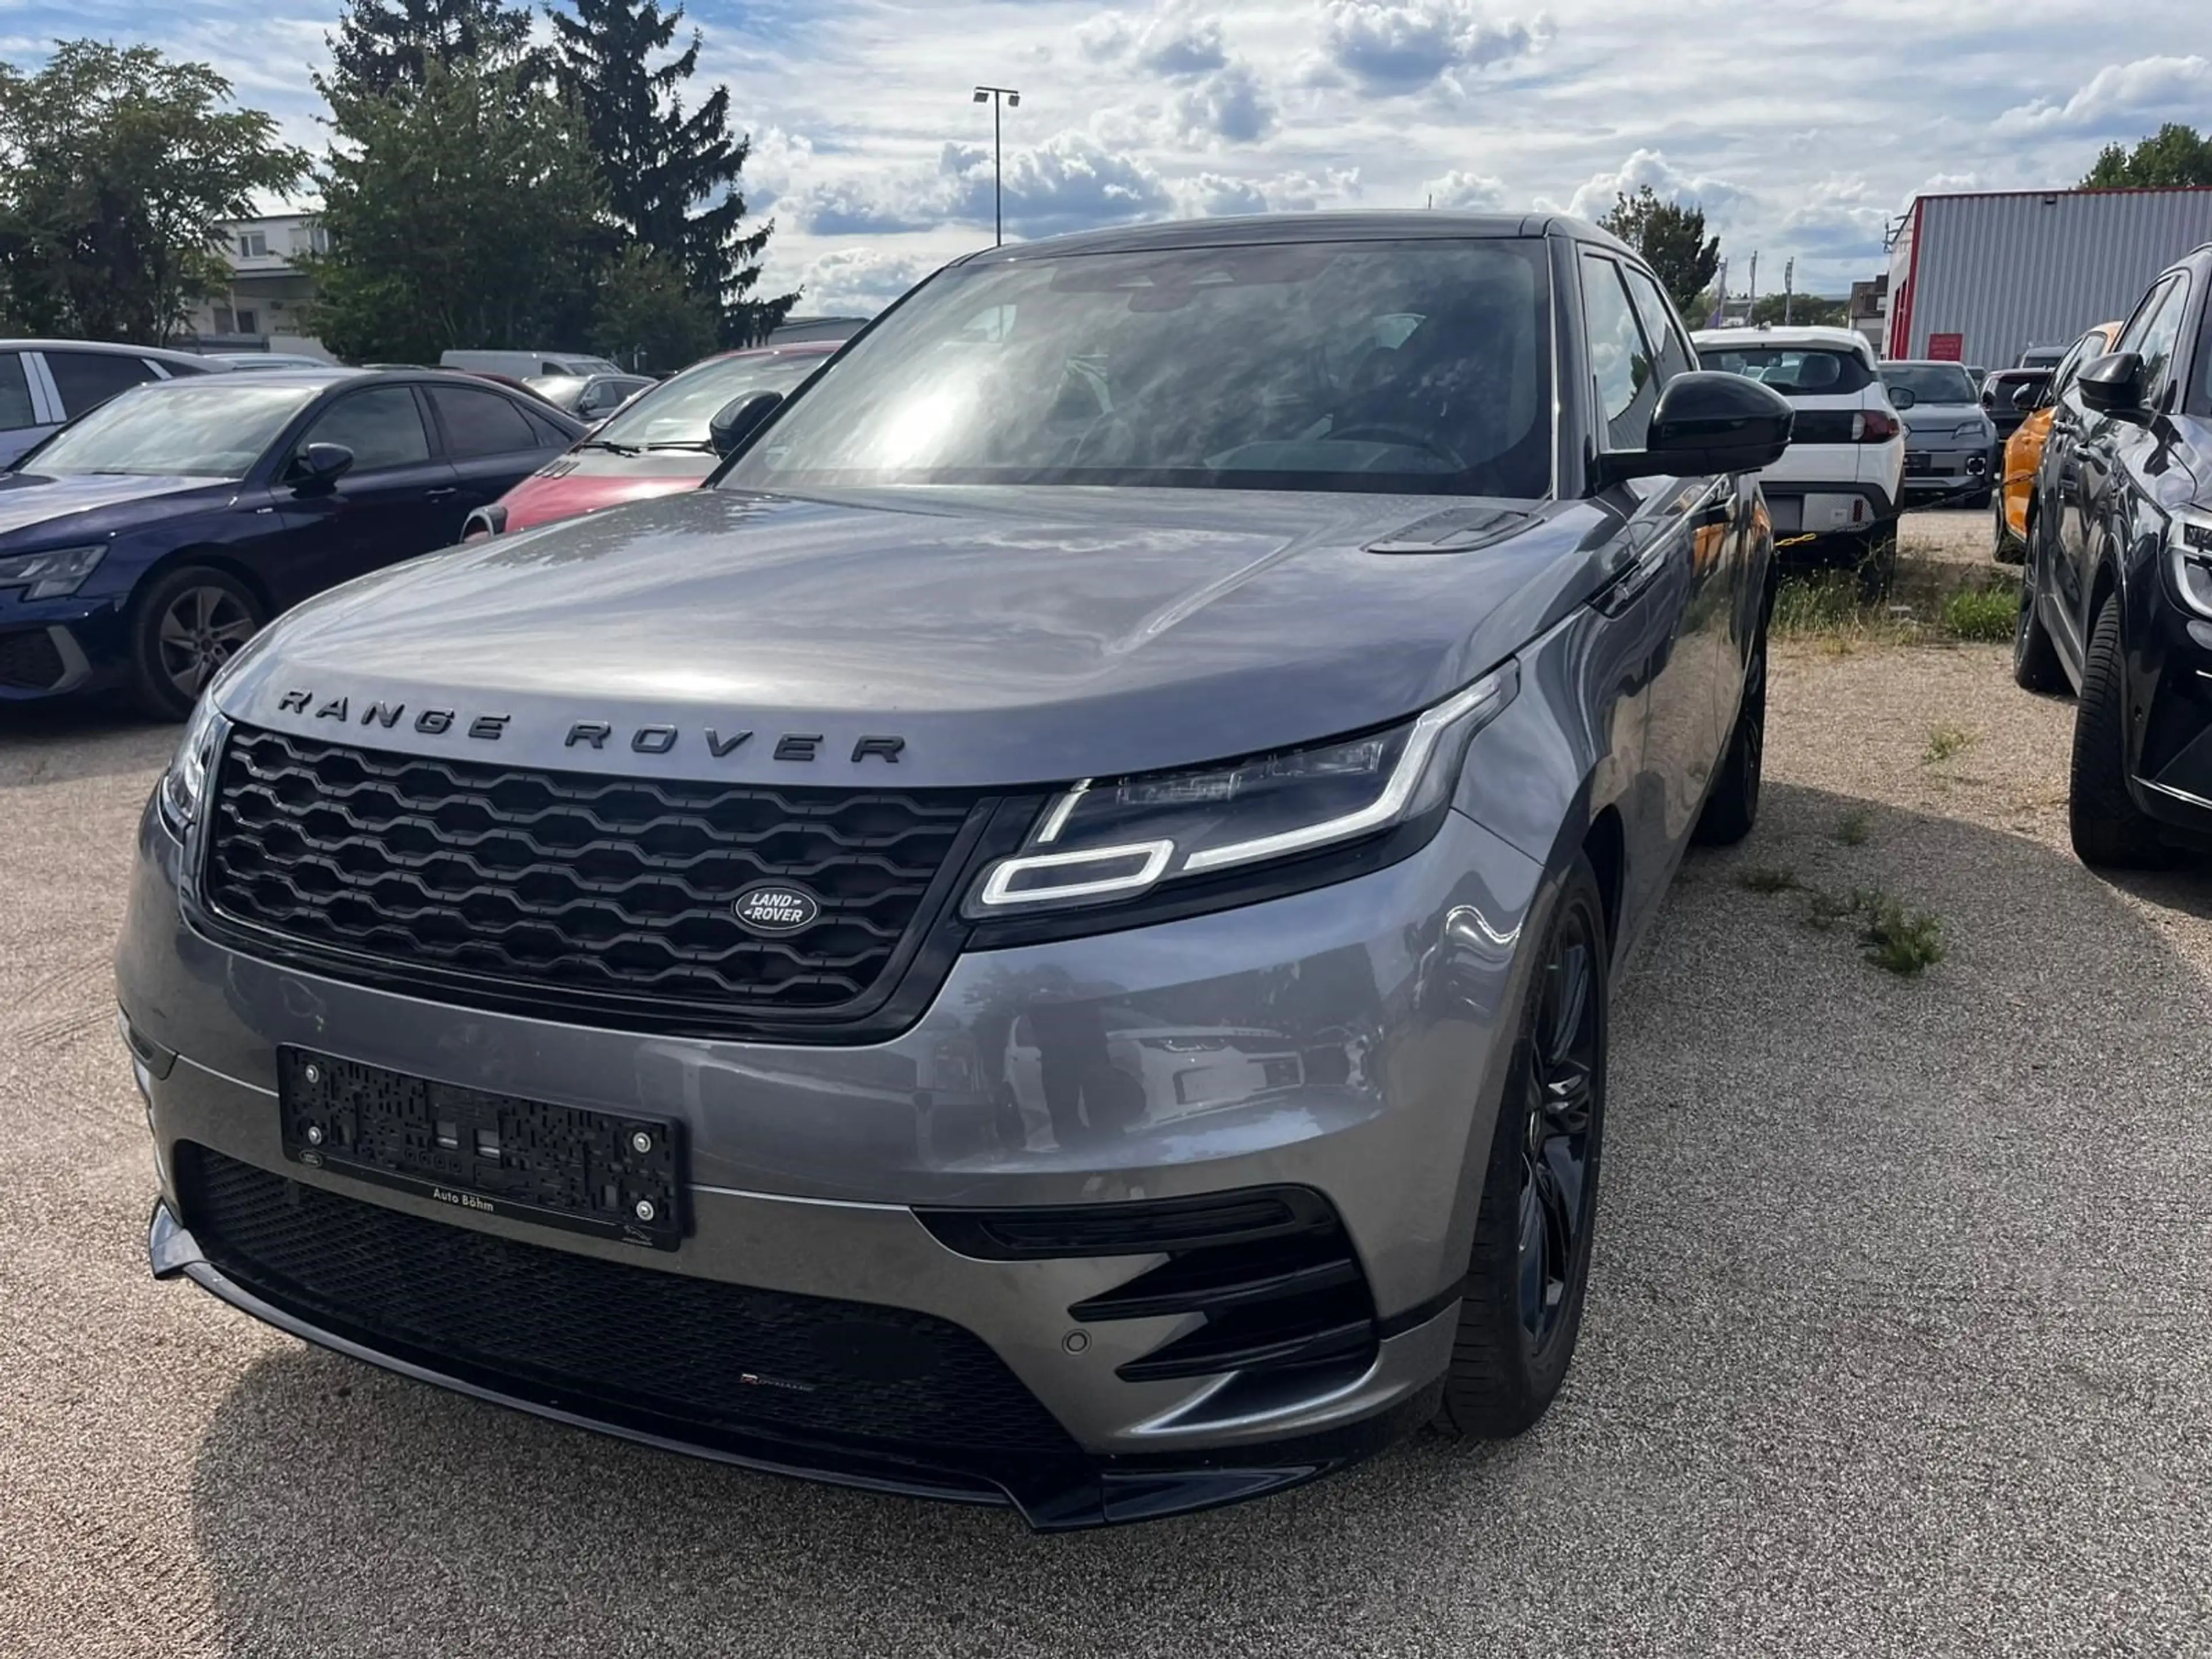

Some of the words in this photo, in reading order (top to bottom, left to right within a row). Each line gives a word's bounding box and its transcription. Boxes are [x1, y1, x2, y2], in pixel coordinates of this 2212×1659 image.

[278, 687, 511, 740] RANGE
[564, 719, 907, 763] ROVER
[433, 1187, 459, 1203] Auto
[462, 1194, 494, 1212] Böhm
